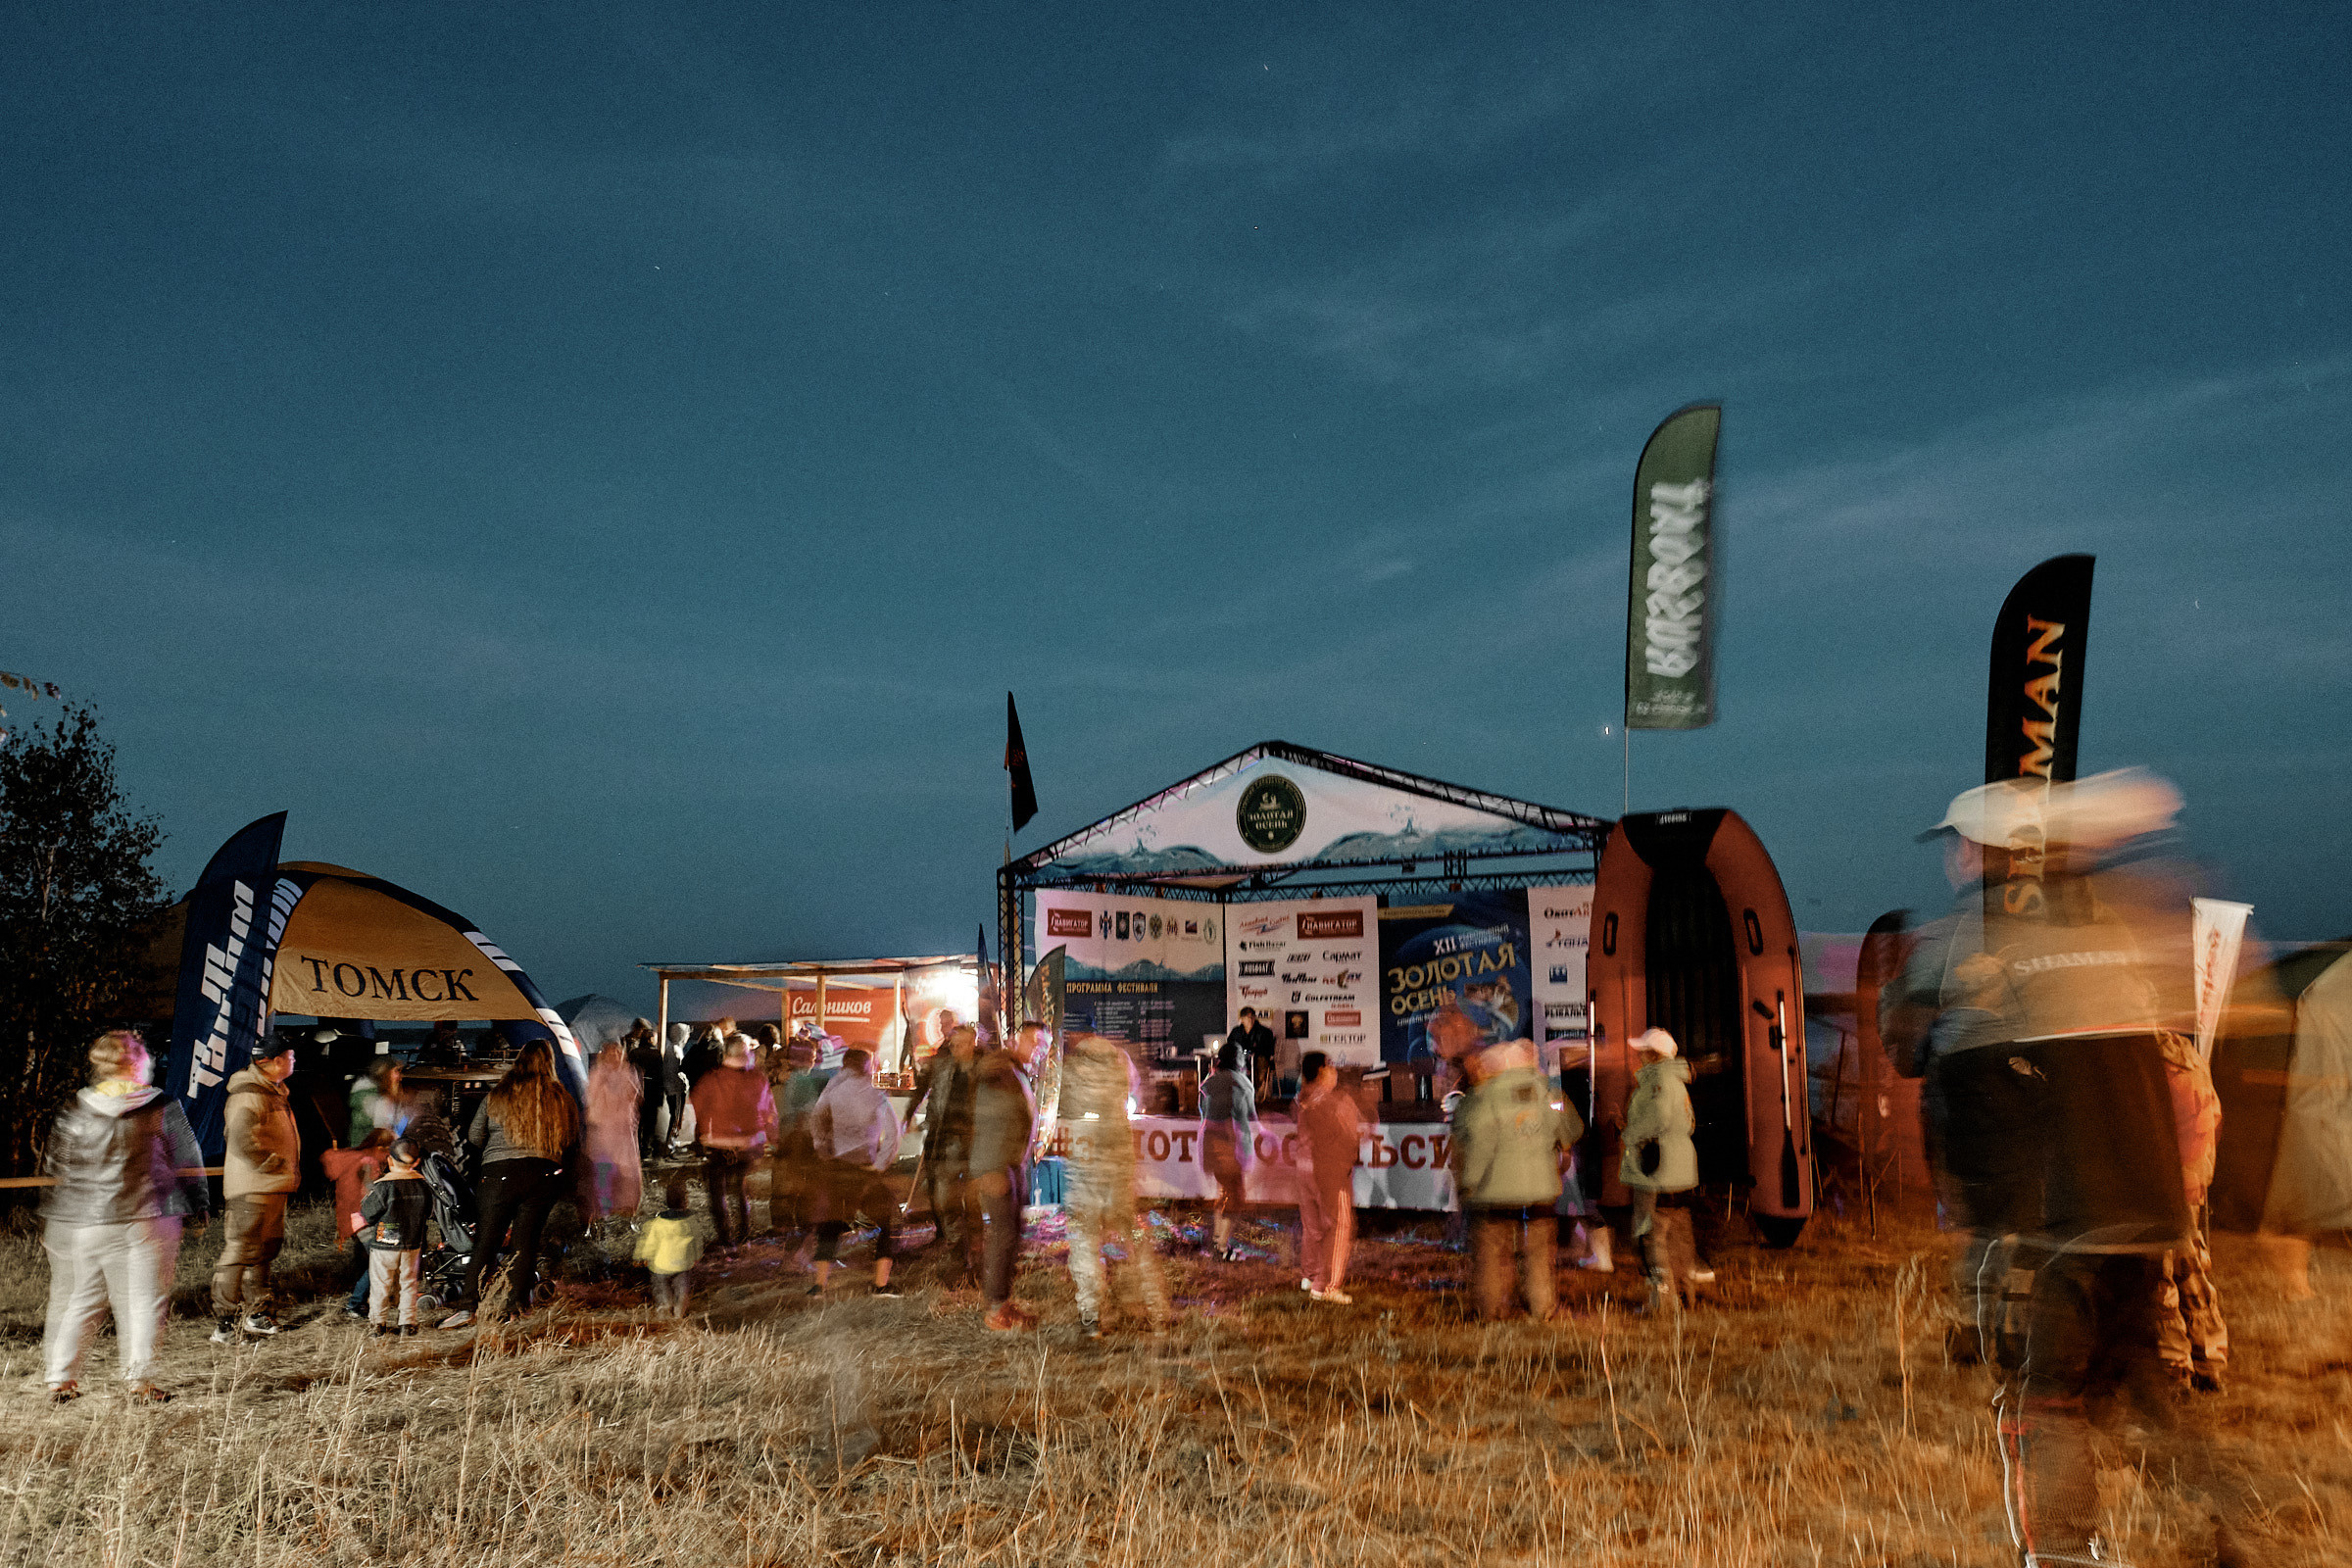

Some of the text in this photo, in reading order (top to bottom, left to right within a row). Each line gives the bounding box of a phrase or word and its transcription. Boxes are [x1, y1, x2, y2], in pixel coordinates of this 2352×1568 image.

[2004, 613, 2065, 917] SHMAN
[1255, 819, 1288, 830] ОСЕНЬ
[300, 955, 479, 1002] ТОМСК
[1388, 943, 1516, 994] ЗОЛОТАЯ
[1066, 982, 1158, 994] ПРОГРАММА ФЕСТИВАЛЯ
[1392, 985, 1455, 1015] ОСЕНЬ
[792, 996, 871, 1014] Салников
